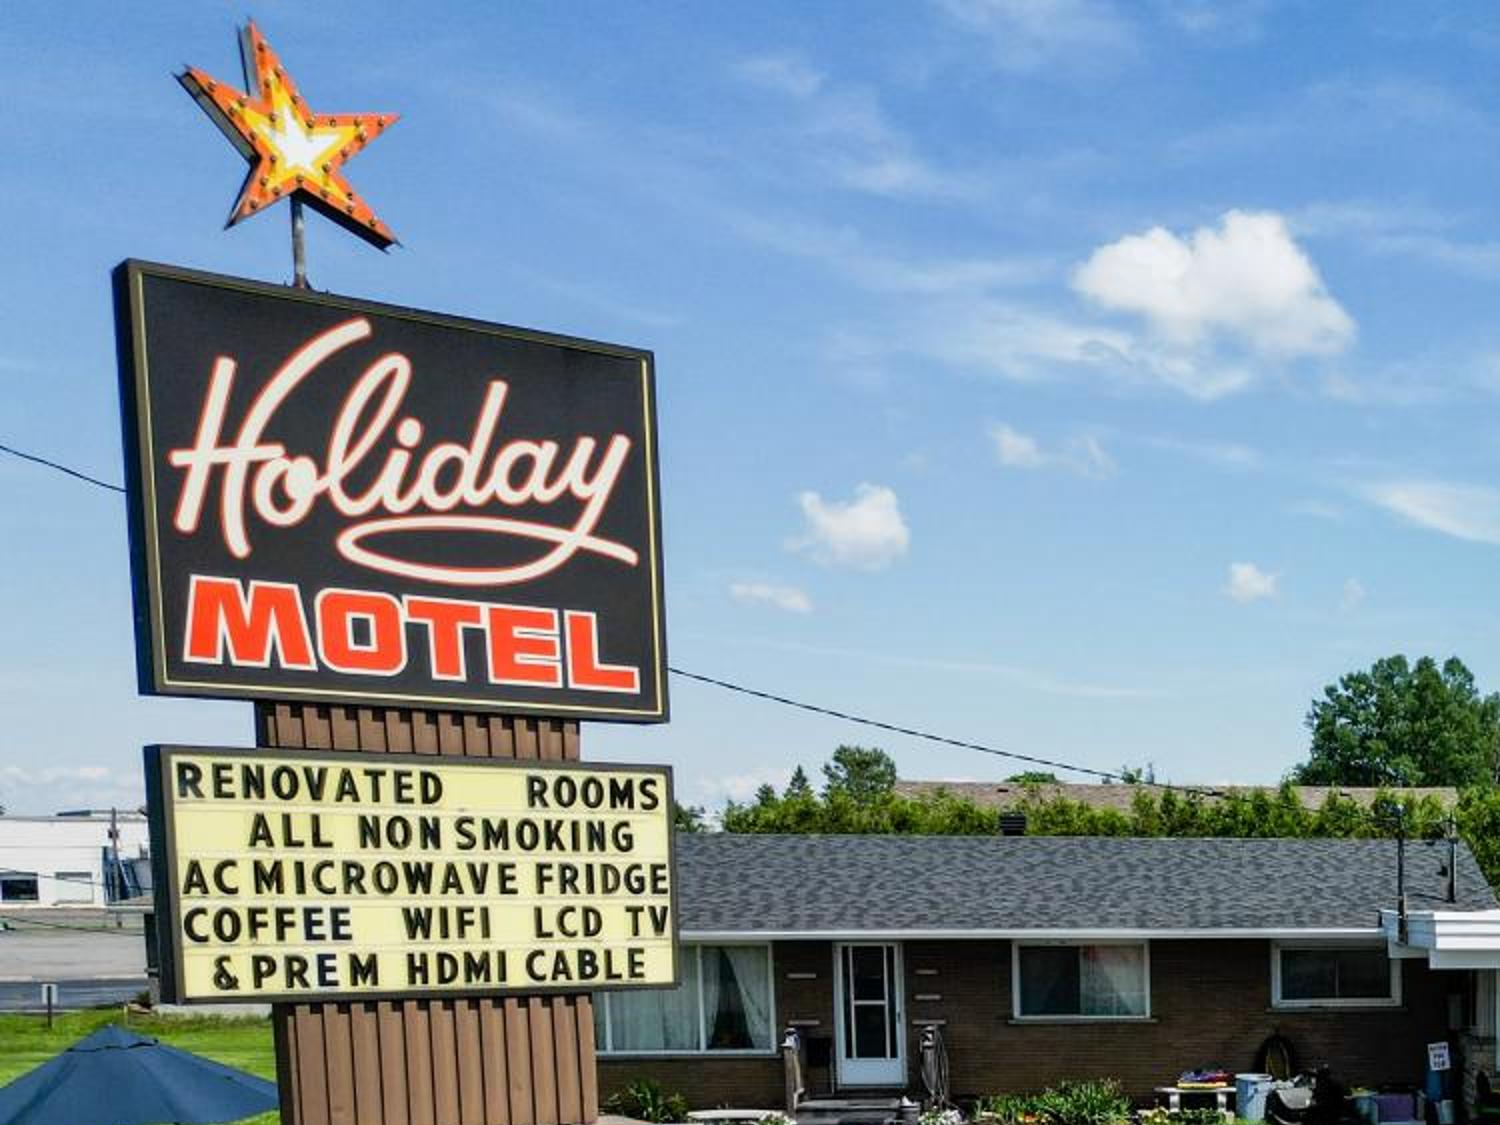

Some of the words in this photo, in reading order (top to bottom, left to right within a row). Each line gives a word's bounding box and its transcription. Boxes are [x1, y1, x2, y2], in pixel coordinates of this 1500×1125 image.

[169, 317, 638, 586] Holiday
[183, 574, 640, 694] MOTEL
[176, 762, 442, 804] RENOVATED
[526, 775, 660, 811] ROOMS
[248, 812, 334, 849] ALL
[359, 815, 441, 850] NON
[455, 817, 634, 853] SMOKING
[182, 859, 239, 896] AC
[253, 860, 519, 896] MICROWAVE
[536, 863, 669, 895] FRIDGE
[183, 905, 353, 944] COFFEE
[402, 905, 492, 940] WIFI
[534, 905, 602, 940] LCD
[625, 905, 669, 937] TV
[407, 950, 507, 986] HDMI
[526, 948, 645, 983] CABLE
